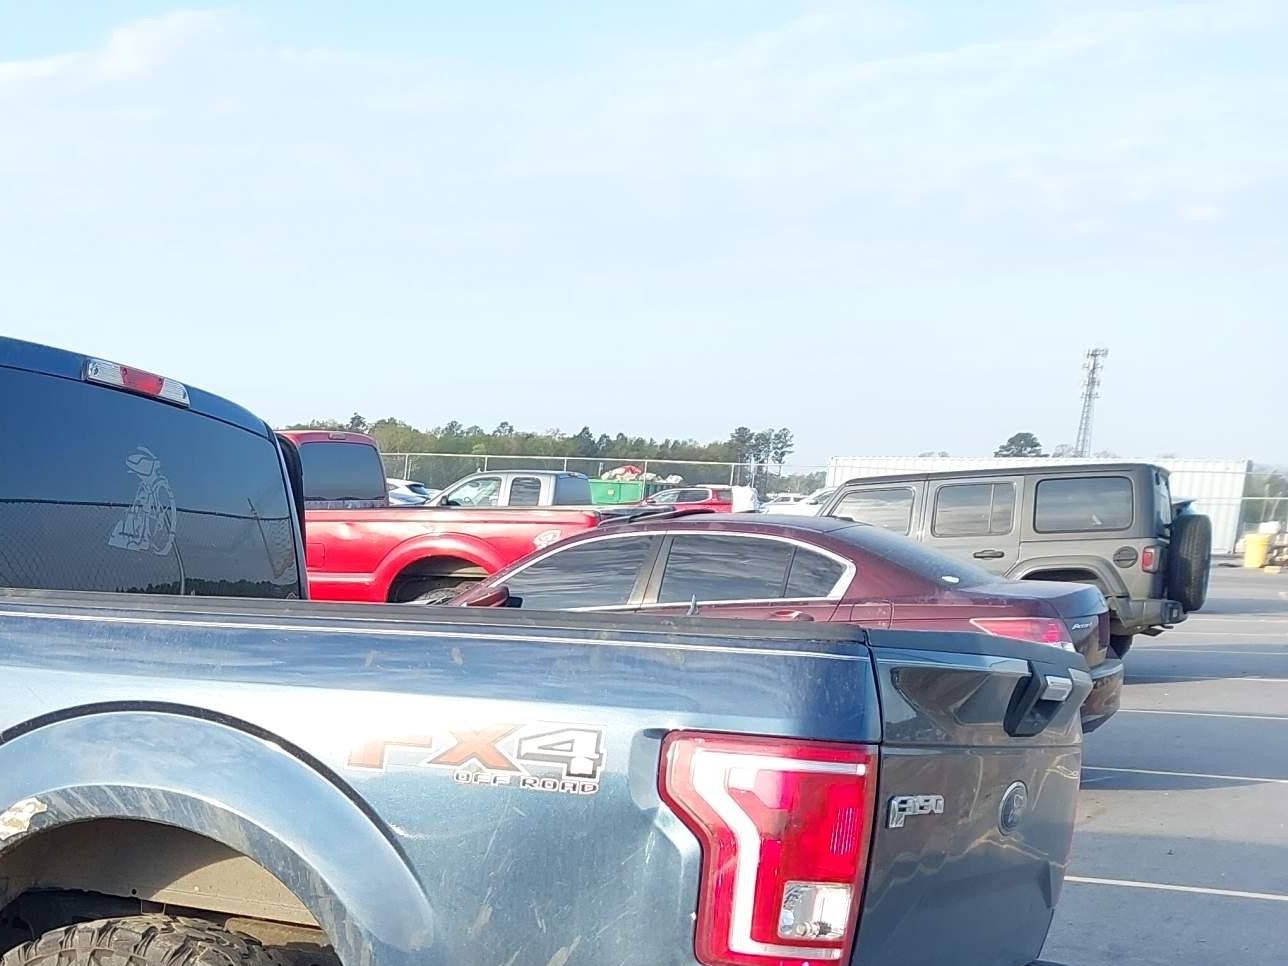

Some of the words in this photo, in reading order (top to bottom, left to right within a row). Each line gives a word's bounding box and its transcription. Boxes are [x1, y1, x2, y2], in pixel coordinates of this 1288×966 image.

[346, 723, 605, 778] FX4
[454, 771, 510, 786] OFF
[520, 778, 599, 795] ROAD
